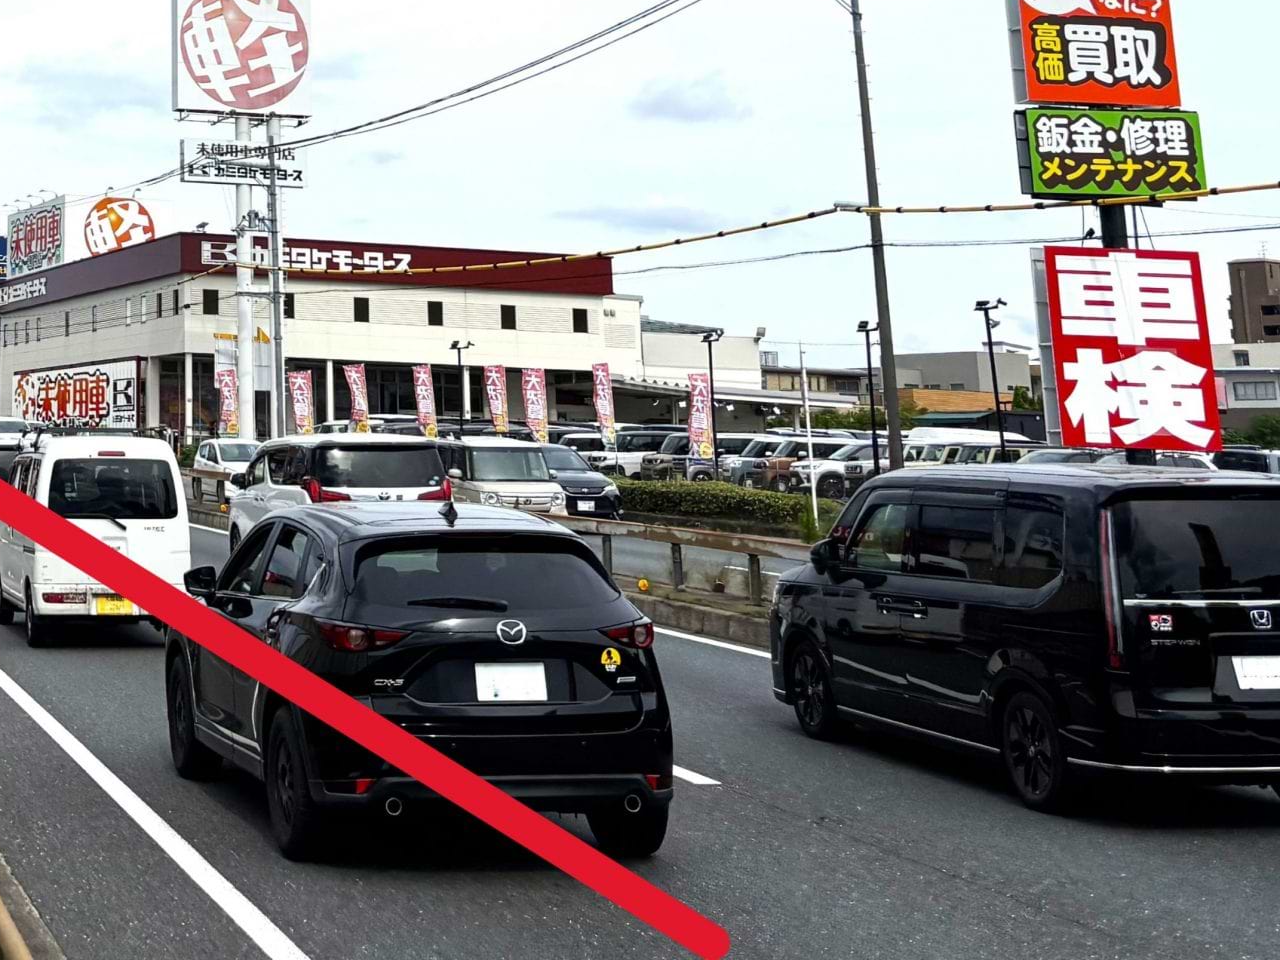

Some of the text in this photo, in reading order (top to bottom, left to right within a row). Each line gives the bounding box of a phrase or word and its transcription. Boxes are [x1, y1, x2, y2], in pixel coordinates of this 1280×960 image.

[1033, 23, 1064, 82] 高価
[1064, 25, 1161, 86] 買取
[1035, 117, 1189, 156] 鈑金・修理
[214, 166, 303, 181] カミタケモタース
[1041, 158, 1193, 185] メンテナンス
[10, 209, 61, 261] 未使用車
[1054, 251, 1215, 449] 車検
[40, 375, 107, 421] 未使用車
